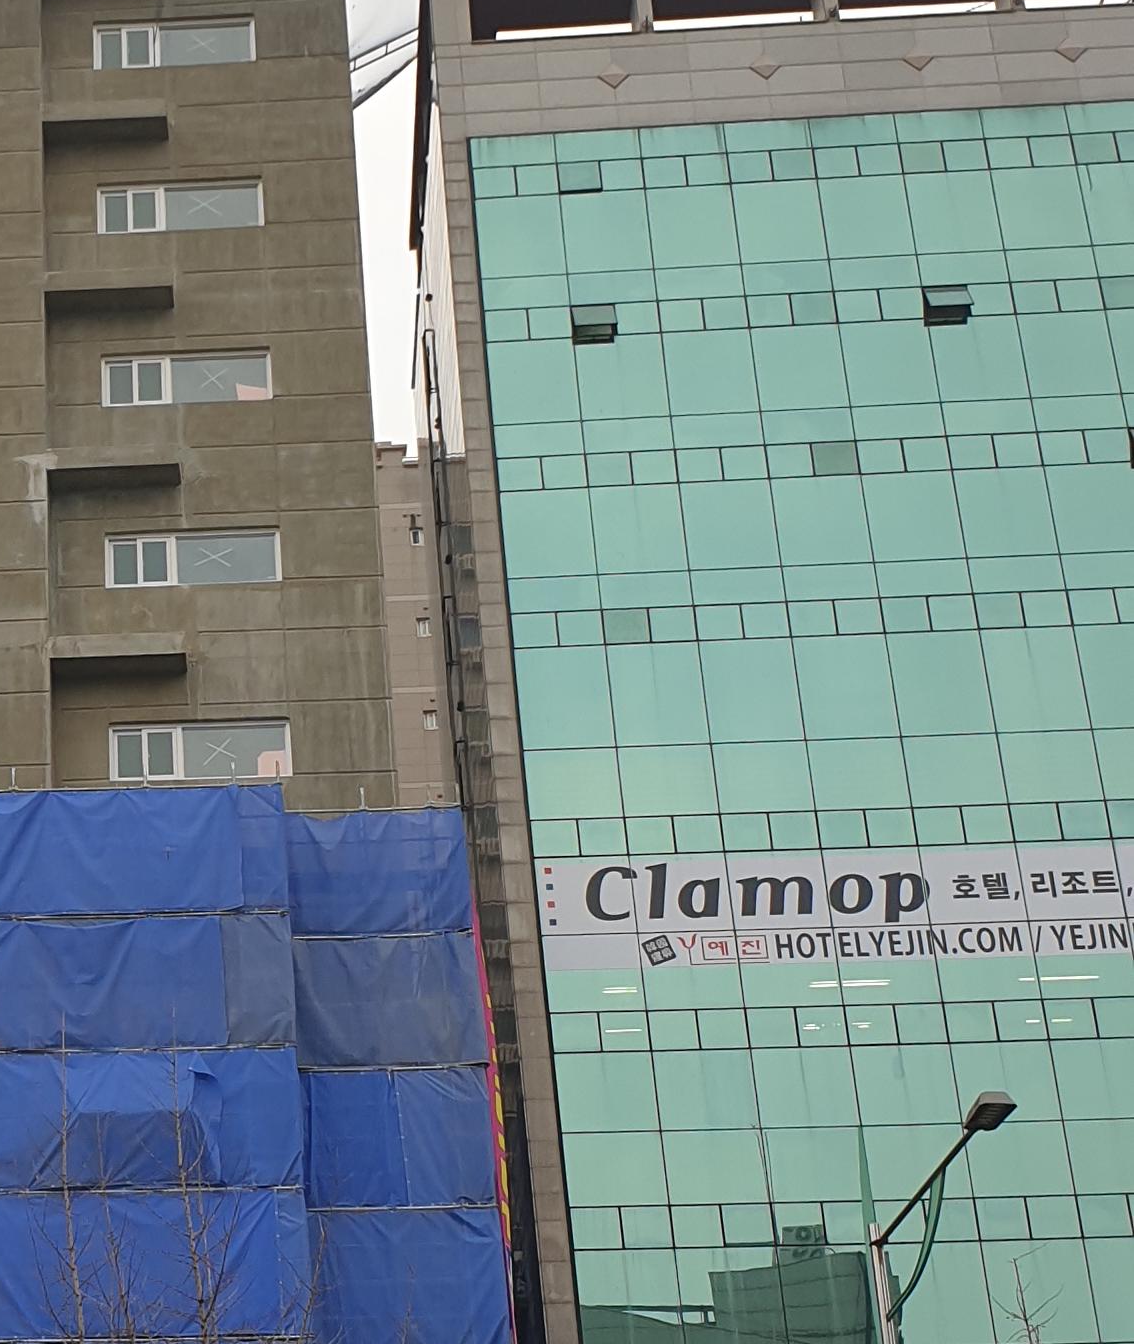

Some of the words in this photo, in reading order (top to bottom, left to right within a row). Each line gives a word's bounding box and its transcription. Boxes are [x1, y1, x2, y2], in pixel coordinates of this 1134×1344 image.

[585, 863, 931, 923] Clamop
[952, 872, 1020, 900] 호텔,
[1030, 871, 1133, 898] 리조트,
[708, 939, 763, 956] 예진
[774, 926, 1023, 960] HOTELYEJIN.COM
[1050, 923, 1134, 952] YEJIN
